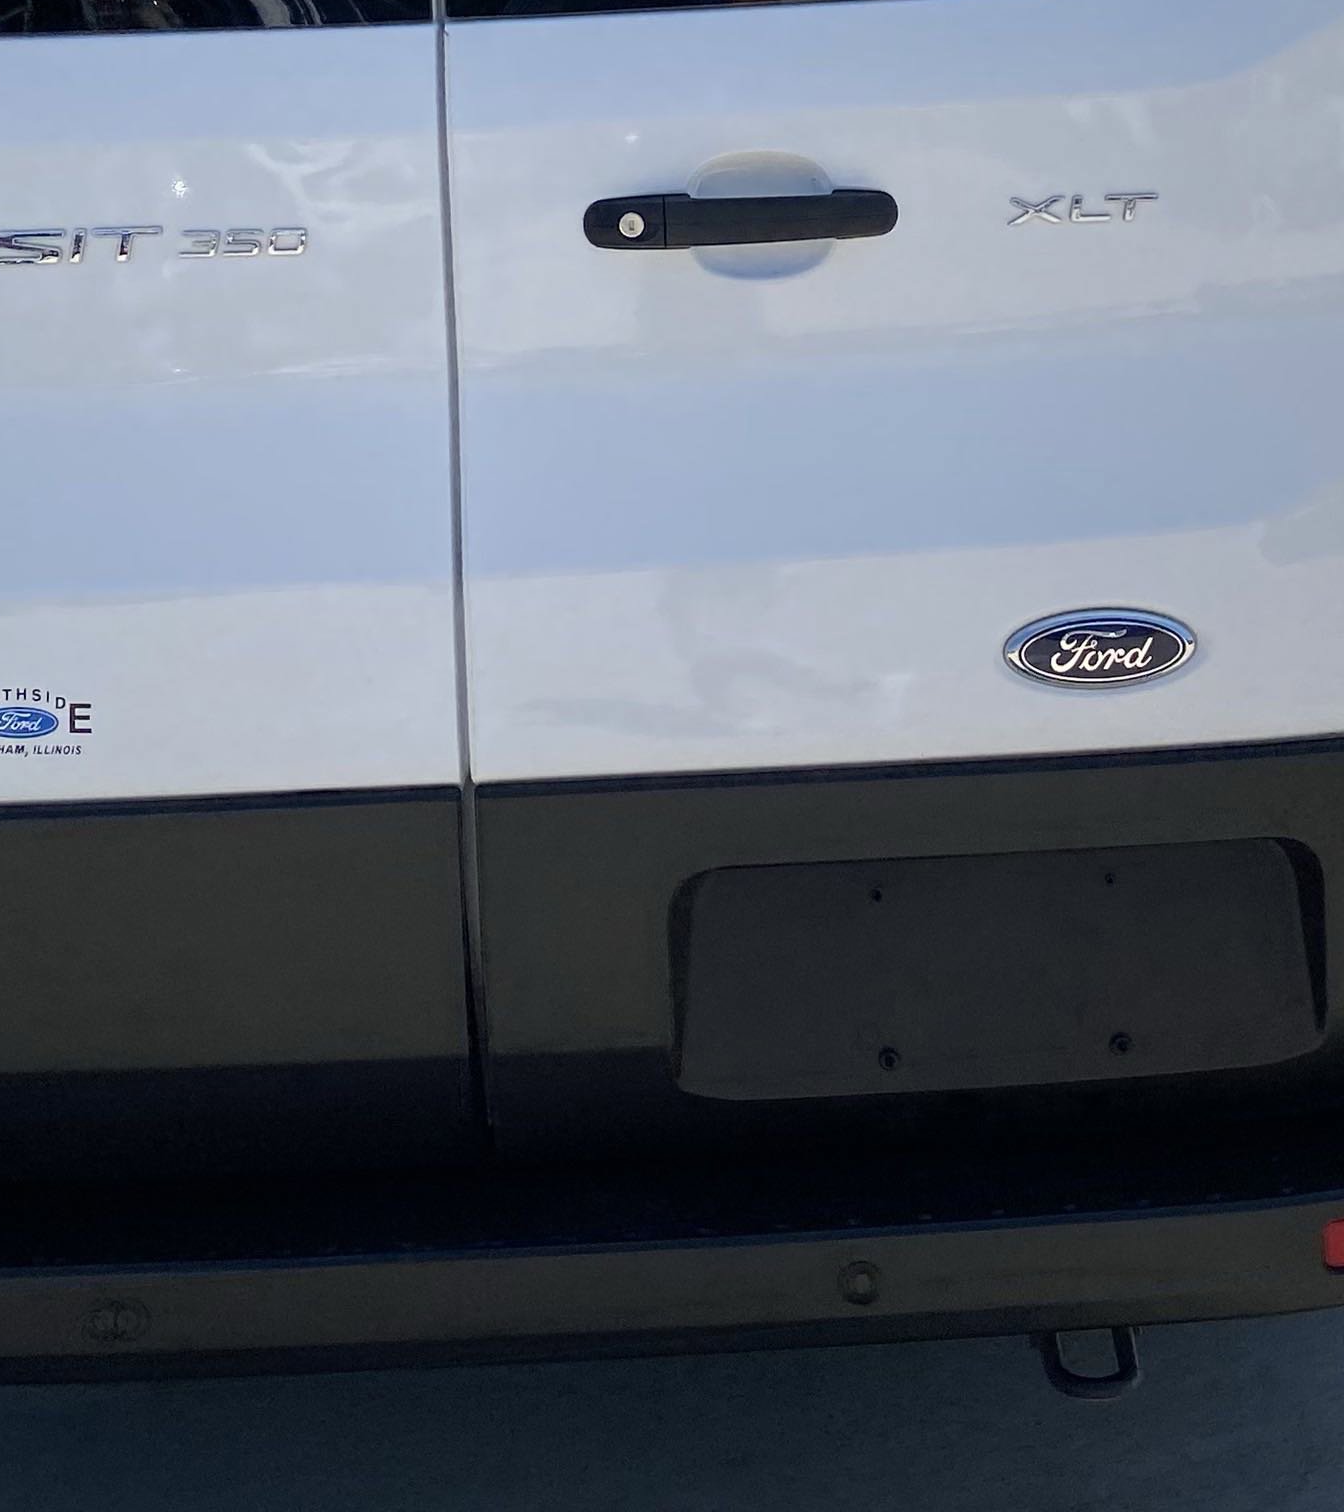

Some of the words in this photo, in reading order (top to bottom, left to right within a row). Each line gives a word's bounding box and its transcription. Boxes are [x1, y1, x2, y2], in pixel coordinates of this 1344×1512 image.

[1006, 192, 1160, 226] XLT
[177, 226, 308, 258] 350
[1050, 628, 1154, 673] Ford
[32, 744, 83, 756] ILLINOIS
